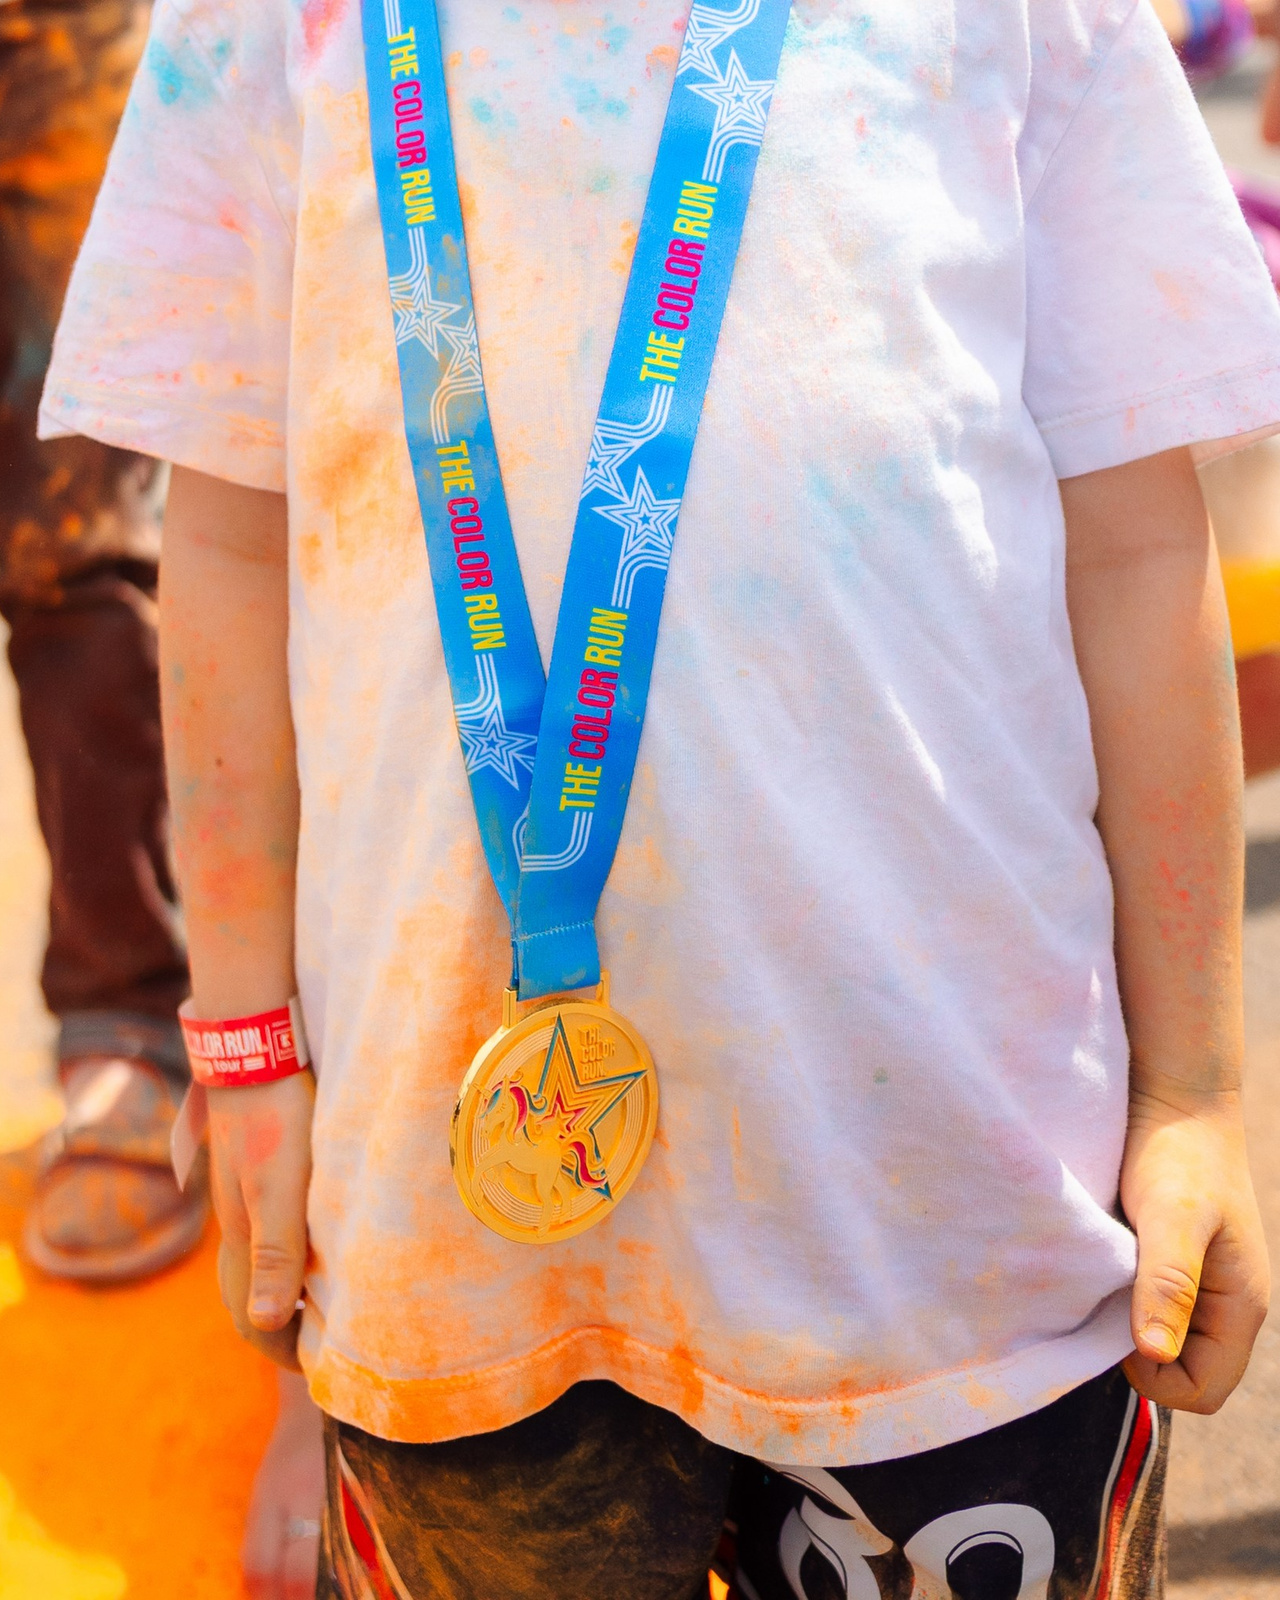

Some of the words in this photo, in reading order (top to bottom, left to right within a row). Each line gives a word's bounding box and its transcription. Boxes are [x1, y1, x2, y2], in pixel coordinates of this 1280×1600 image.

[387, 26, 419, 80] THE
[392, 79, 428, 169] COLOR
[400, 168, 437, 225] RUN
[673, 180, 718, 239] RUN
[652, 238, 706, 331] COLOR
[639, 331, 685, 382] THE
[436, 439, 476, 494] THE
[447, 496, 494, 590] COLOR
[464, 593, 507, 650] RUN
[584, 607, 628, 667] RUN
[568, 668, 619, 760] COLOR
[559, 762, 602, 812] THE
